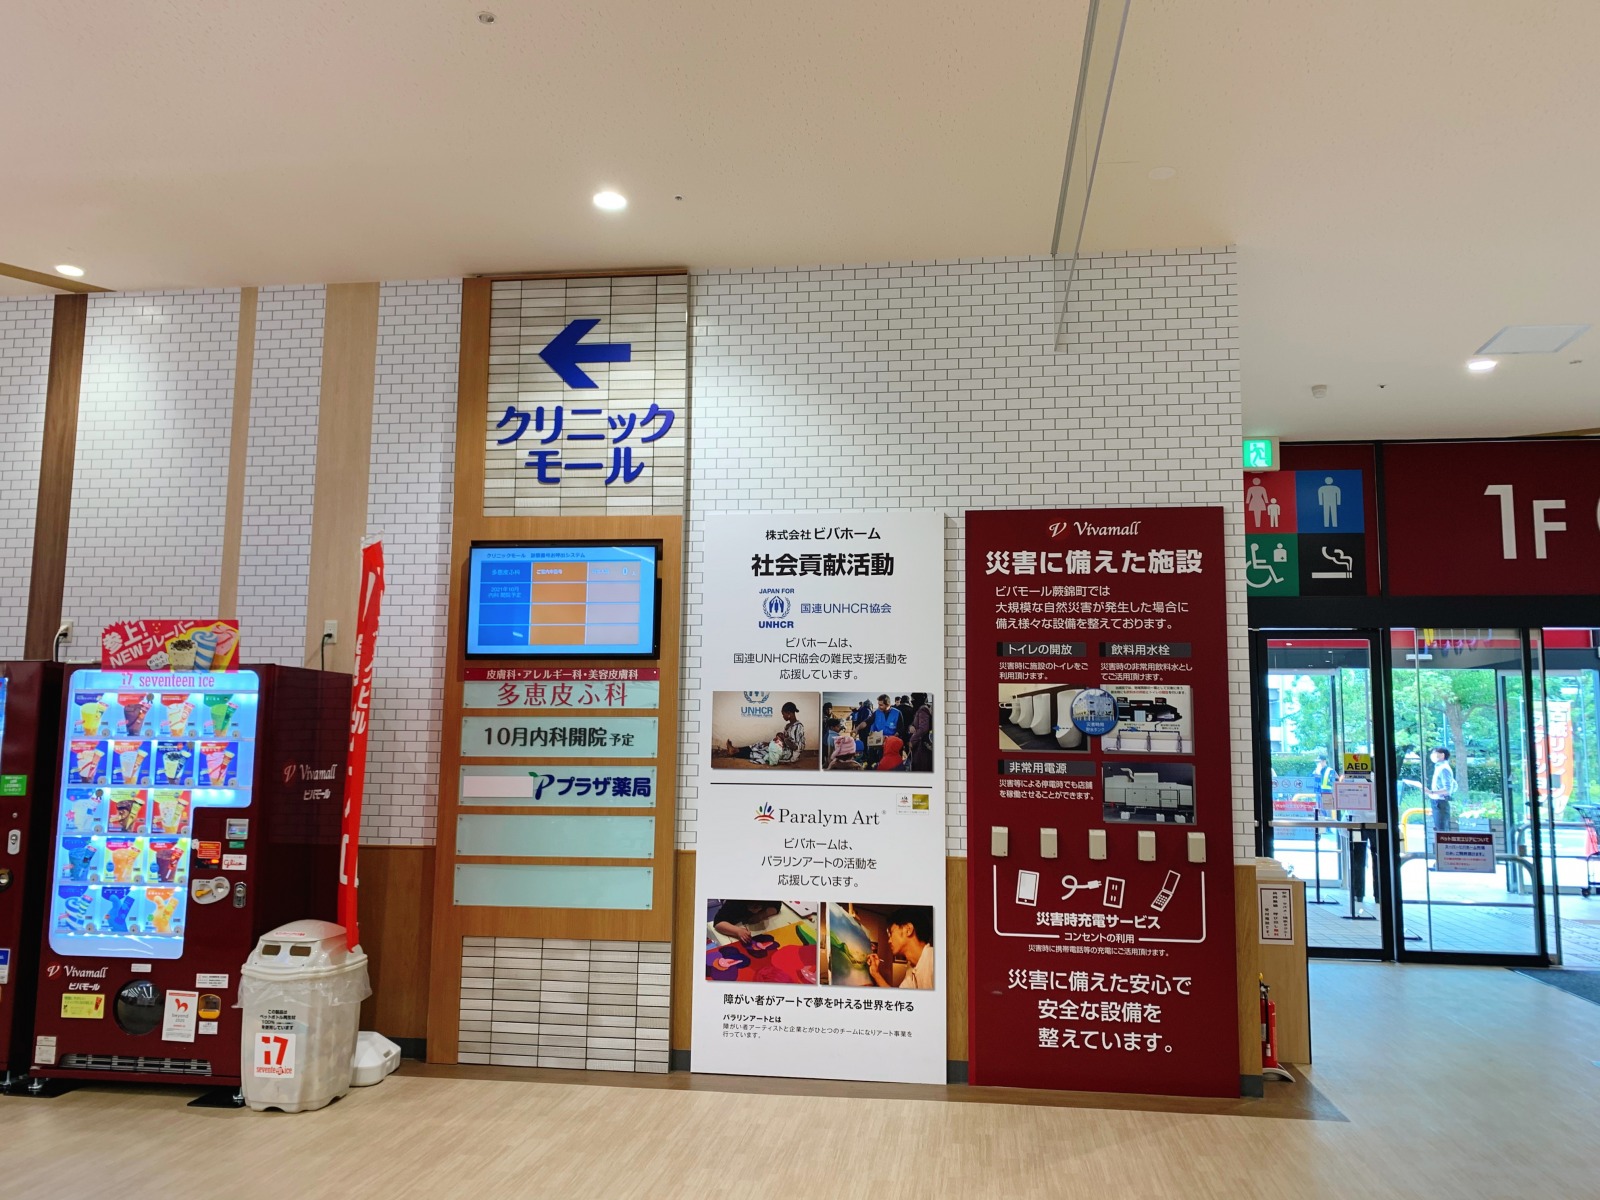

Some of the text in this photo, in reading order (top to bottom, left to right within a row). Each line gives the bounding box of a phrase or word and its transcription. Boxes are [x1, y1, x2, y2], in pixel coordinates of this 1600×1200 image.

[496, 403, 675, 445] クリニック
[524, 446, 645, 485] モール
[1483, 484, 1567, 559] 1F
[1073, 521, 1142, 536] Vivamall
[751, 552, 895, 577] 社会貢献活動
[985, 549, 1203, 575] 災害に備えた施設
[995, 585, 1111, 598] ビバモール蕨錦町では
[800, 602, 892, 614] 国連UNHCR協会
[995, 601, 1189, 614] 大規模な自然災害が発生した場合に
[758, 621, 794, 629] UNHCR
[995, 618, 1173, 630] 備え様々な設備を整えております。
[786, 637, 853, 649] ビバホームは、
[1007, 643, 1073, 656] トイレの開放
[1111, 644, 1170, 656] 飲料用水栓
[733, 652, 908, 665] 国連UNHCR協会の難民支援活動を
[999, 662, 1089, 671] 災害時に施設のトイレをご
[1100, 663, 1193, 672] 災害時の非常用飲料水とし
[139, 675, 195, 687] seventeen
[198, 675, 215, 687] ice
[486, 669, 639, 680] 皮膚科・アレルギー科・美容皮膚科
[779, 668, 859, 681] 応援しています。
[999, 672, 1048, 681] 利用頂けます。
[1101, 672, 1164, 681] てご活用頂けます。
[497, 682, 627, 707] 多恵皮ふ科
[740, 706, 773, 714] UNHCR
[484, 727, 635, 747] 10月内科開院予定
[300, 764, 338, 780] Vivamall
[1009, 762, 1068, 774] 非常用電源
[1346, 762, 1369, 771] AED
[556, 776, 651, 798] プラザ薬局
[999, 779, 1093, 790] 災害等による停電時でも店舗
[999, 790, 1094, 800] を稼働させることができます。
[778, 808, 880, 827] Paralym Art
[784, 838, 853, 851] ビバホームは、
[777, 874, 859, 888] 応援しています。
[1036, 911, 1161, 929] 災害時充電サービス
[1064, 932, 1135, 944] コンセントの利用
[1028, 944, 1169, 957] 災害時に携帯電話等の充電にご活用頂けます。
[64, 966, 109, 978] Vivamall
[68, 982, 101, 991] ビバモール
[1007, 968, 1192, 996] 災害に備えた安心で
[723, 994, 915, 1012] 障がい者がアートで夢を叶える世界を作る
[1038, 999, 1162, 1023] 安全な設備を
[722, 1031, 761, 1039] 行っています。
[1038, 1027, 1173, 1053] 整えています。
